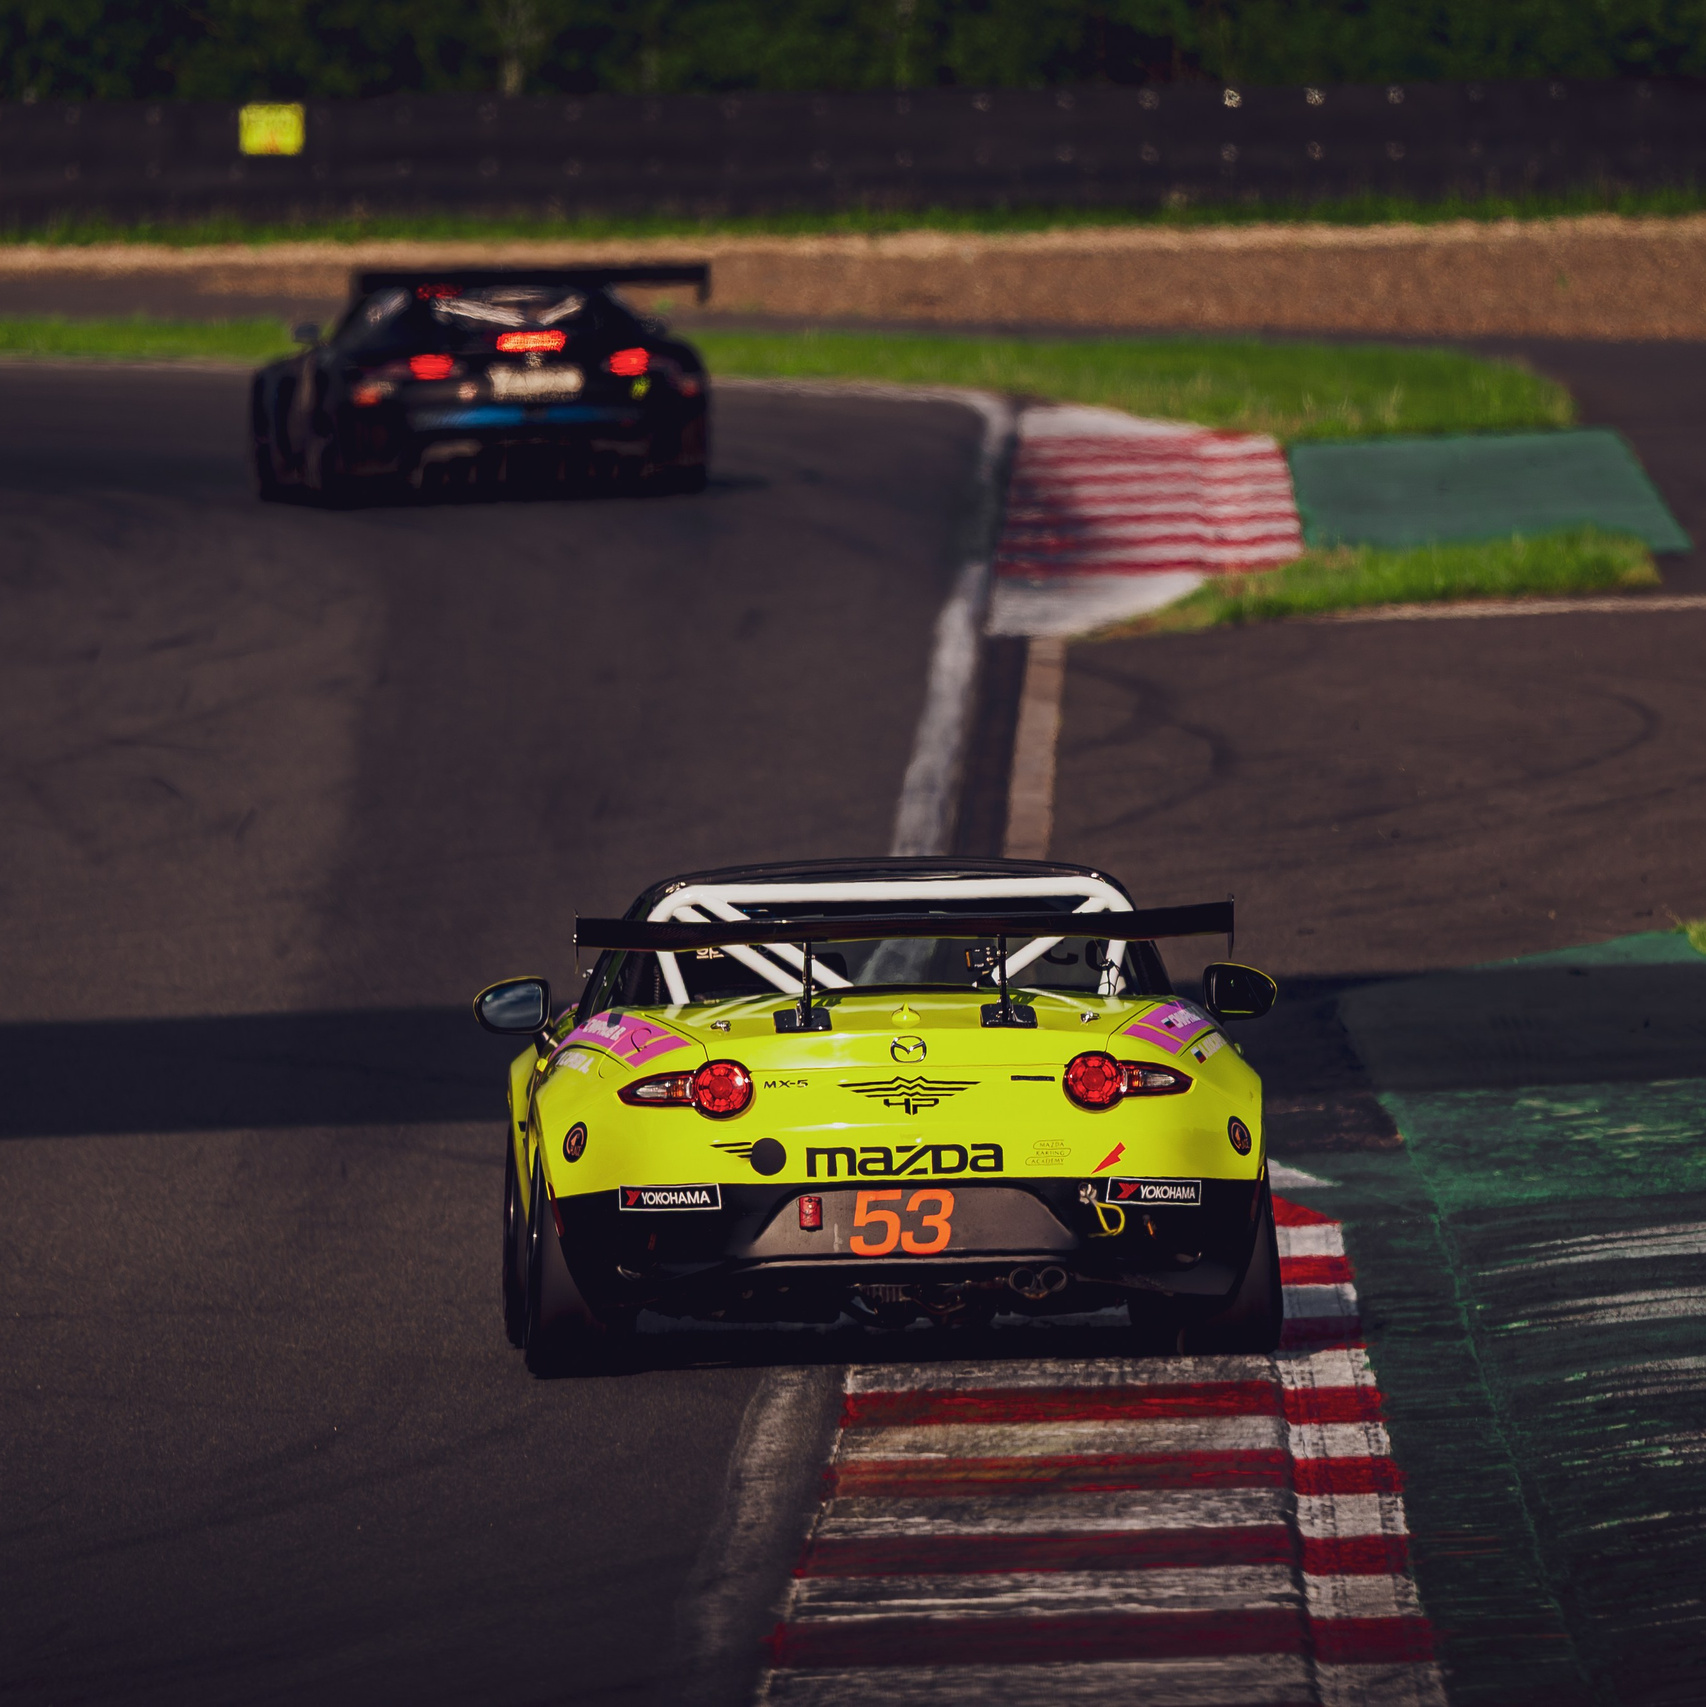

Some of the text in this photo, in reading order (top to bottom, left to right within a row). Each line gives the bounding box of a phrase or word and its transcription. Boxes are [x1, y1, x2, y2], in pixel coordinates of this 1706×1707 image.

[763, 1079, 809, 1090] MX-5
[641, 1189, 711, 1206] YOKOHAMA
[1140, 1184, 1196, 1200] YOKOHAMA
[849, 1188, 955, 1257] 53
